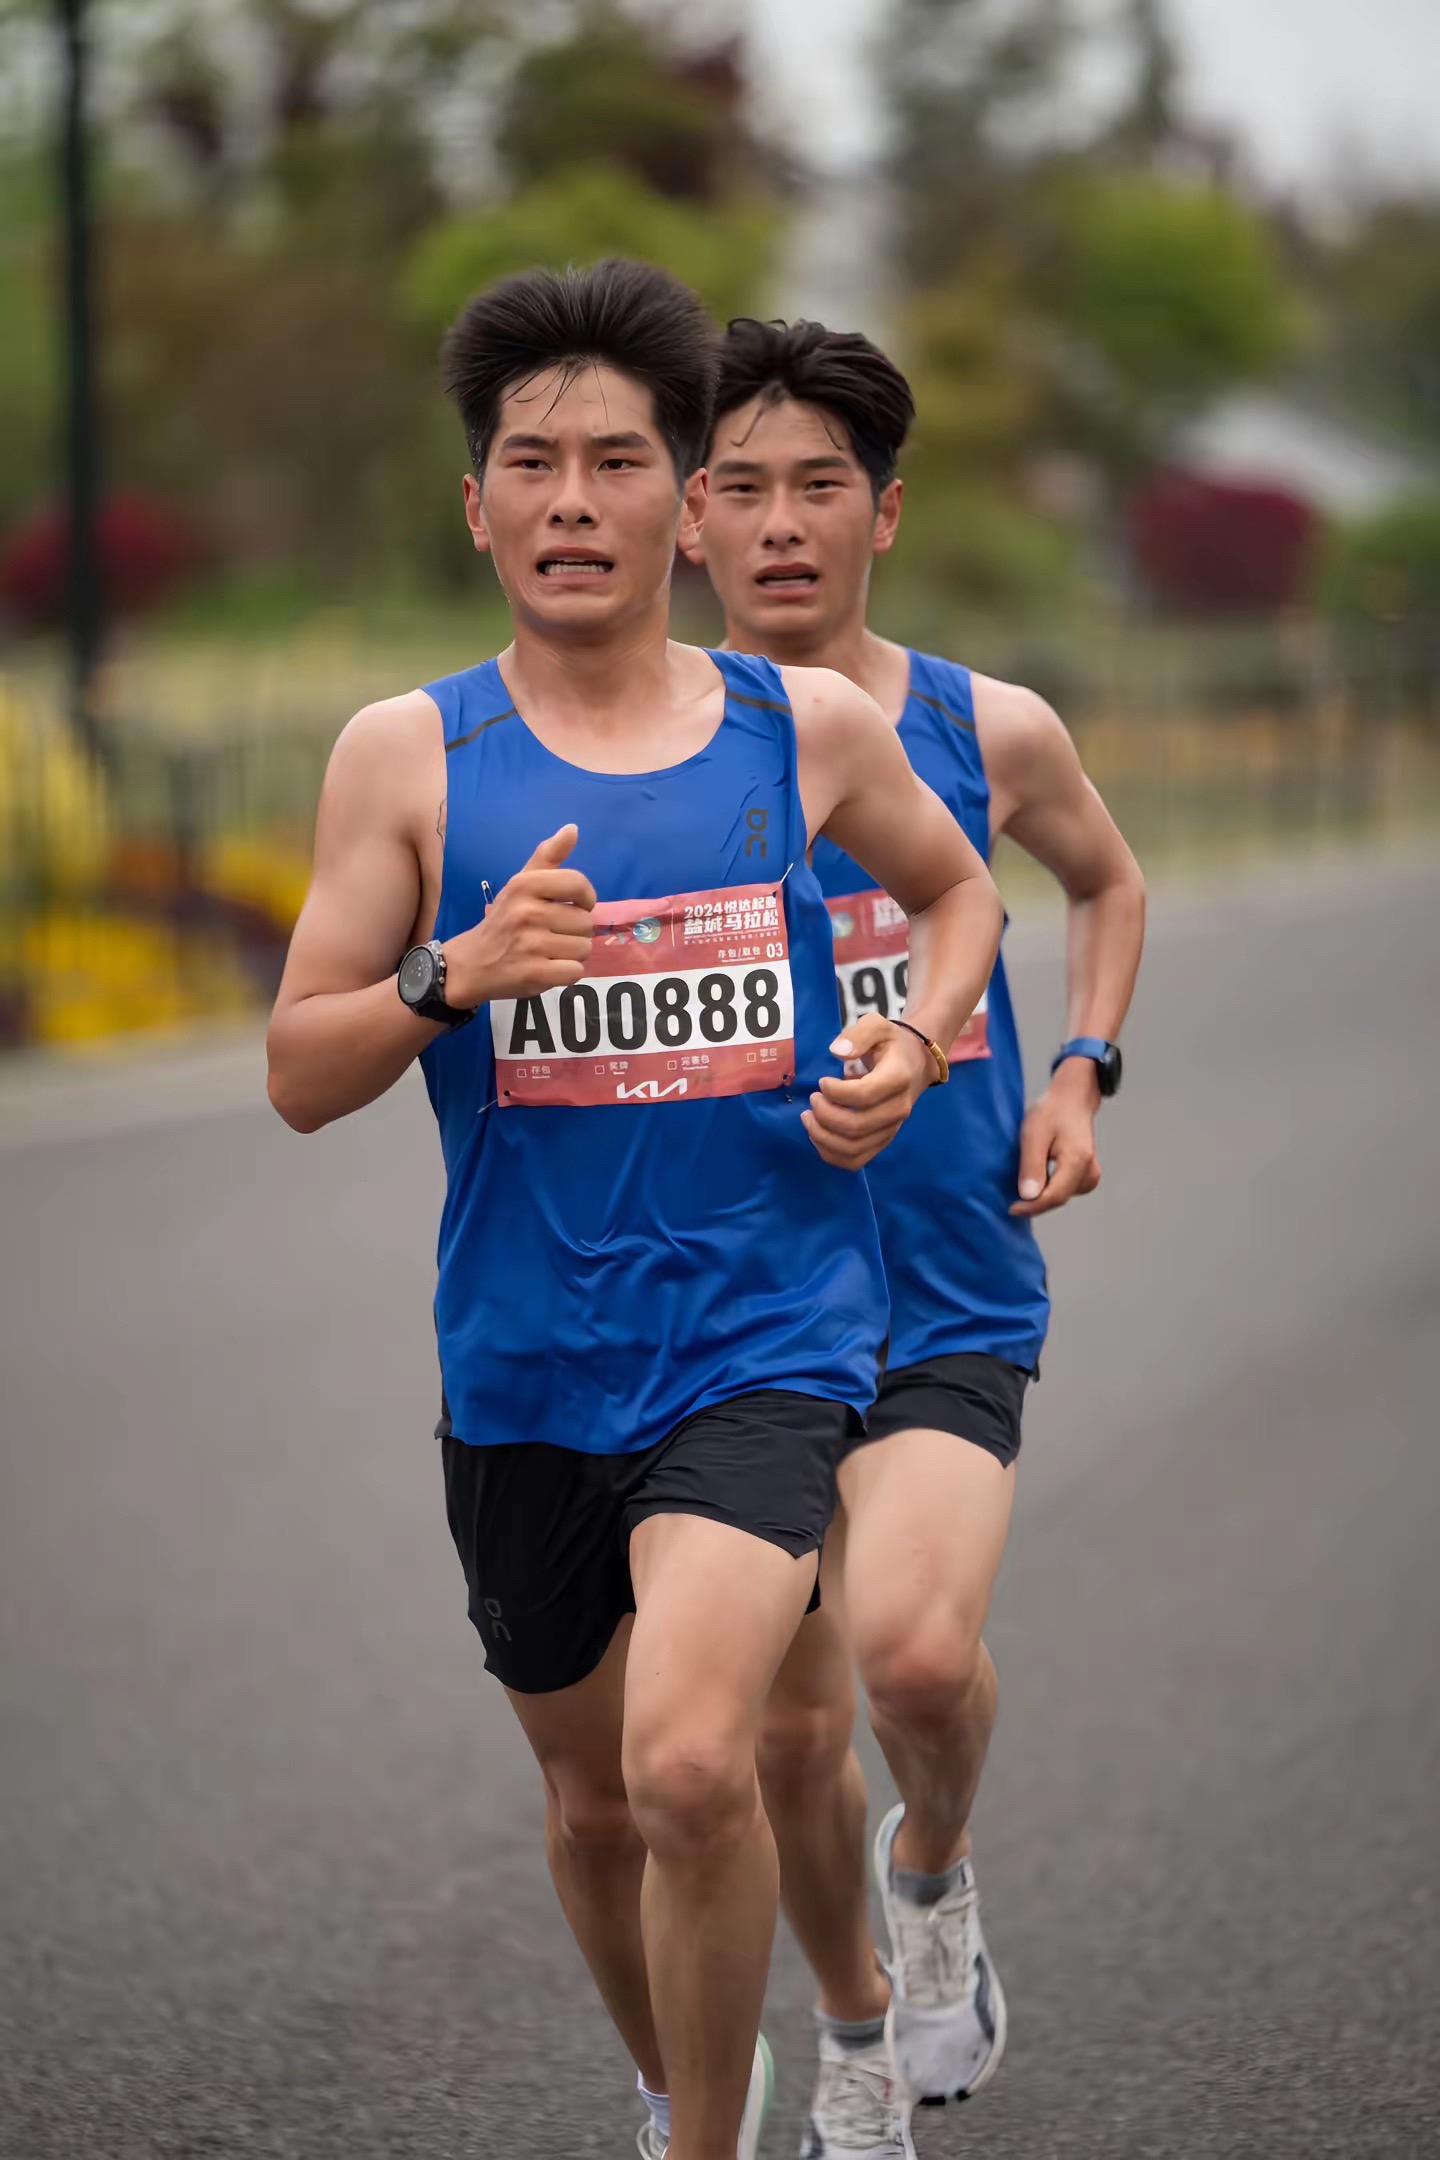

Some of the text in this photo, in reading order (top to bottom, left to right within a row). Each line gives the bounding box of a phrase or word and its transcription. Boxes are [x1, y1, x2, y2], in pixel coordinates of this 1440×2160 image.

[683, 909, 779, 935] 盐城马拉松
[766, 942, 784, 958] 03
[508, 969, 781, 1054] A00888
